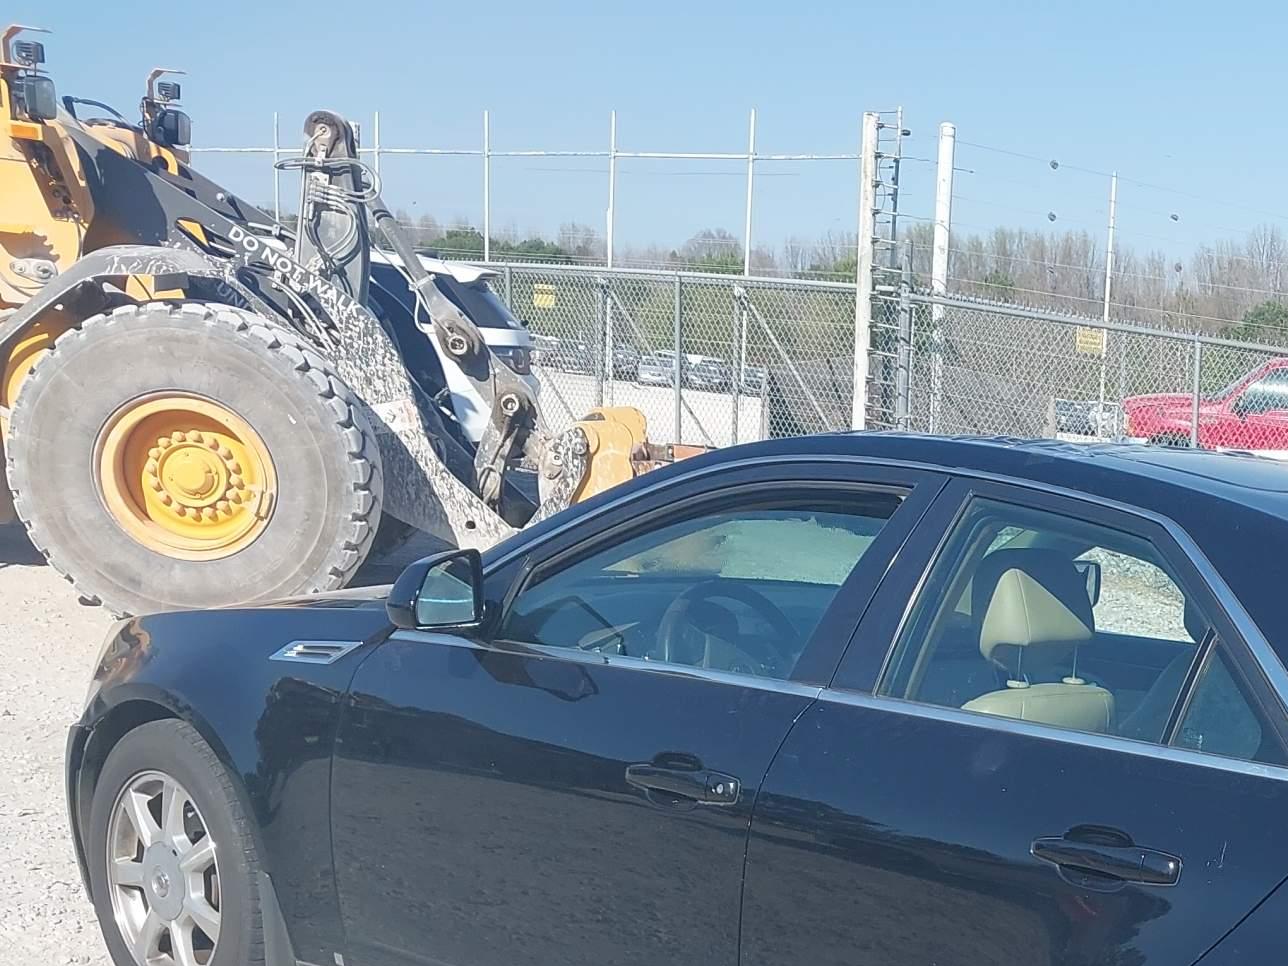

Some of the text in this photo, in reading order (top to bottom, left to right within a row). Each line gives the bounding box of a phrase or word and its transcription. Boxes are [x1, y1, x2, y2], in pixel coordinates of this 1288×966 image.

[216, 283, 249, 309] UN
[228, 226, 361, 317] DO NOT WALK
